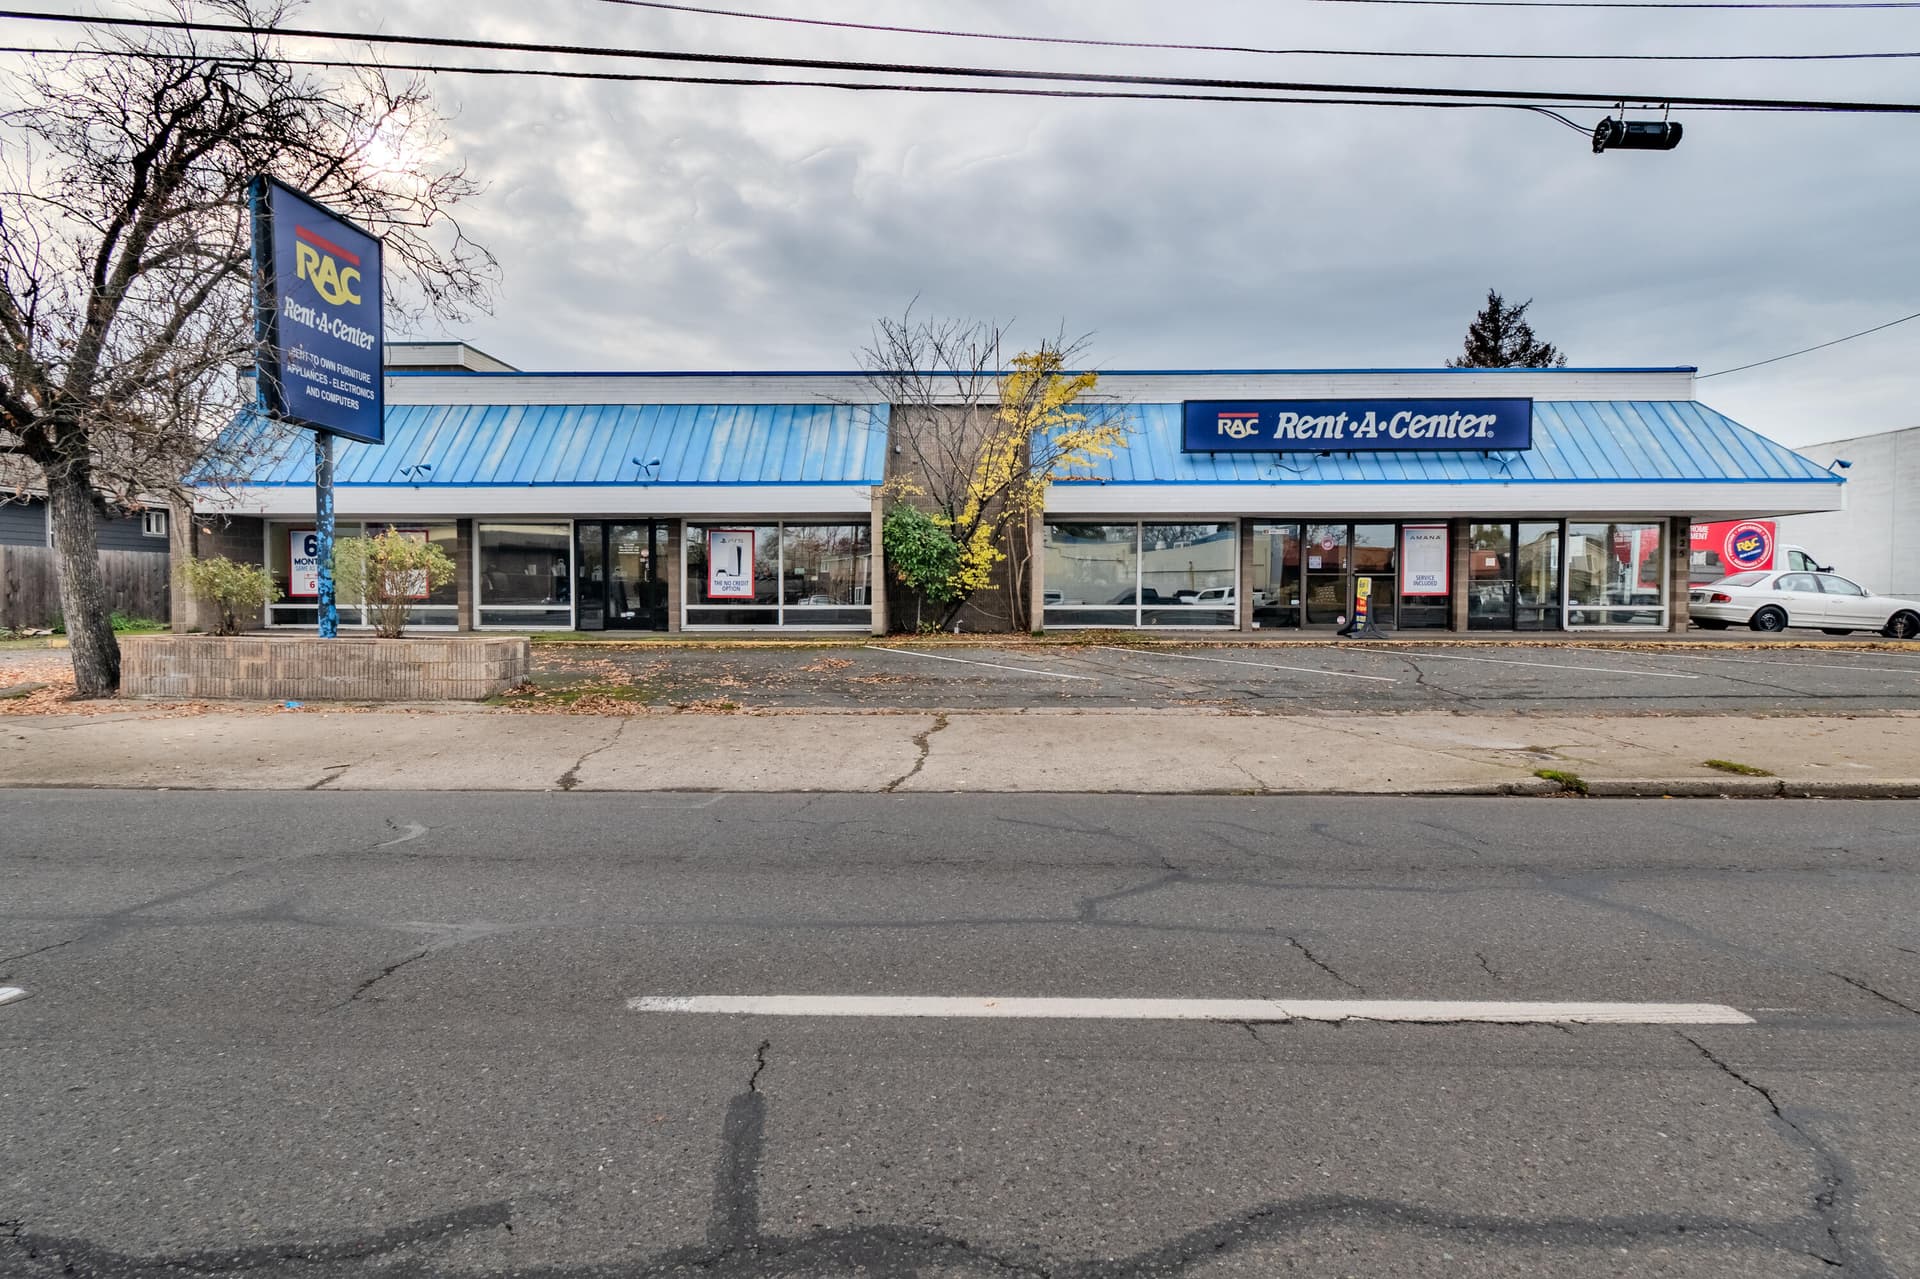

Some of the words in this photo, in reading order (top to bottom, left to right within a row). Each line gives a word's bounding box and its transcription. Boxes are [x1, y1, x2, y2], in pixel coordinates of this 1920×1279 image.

[296, 240, 361, 306] RAC
[287, 363, 328, 385] APPLIANCES
[333, 378, 375, 400] ELECTRONICS
[320, 357, 336, 372] OWN
[337, 363, 371, 384] FURNITURE
[306, 385, 320, 398] AND
[321, 390, 360, 410] COMPUTERS
[1218, 418, 1259, 439] RAC
[304, 534, 319, 557] 6
[1736, 537, 1760, 552] RAC
[309, 581, 316, 589] 6
